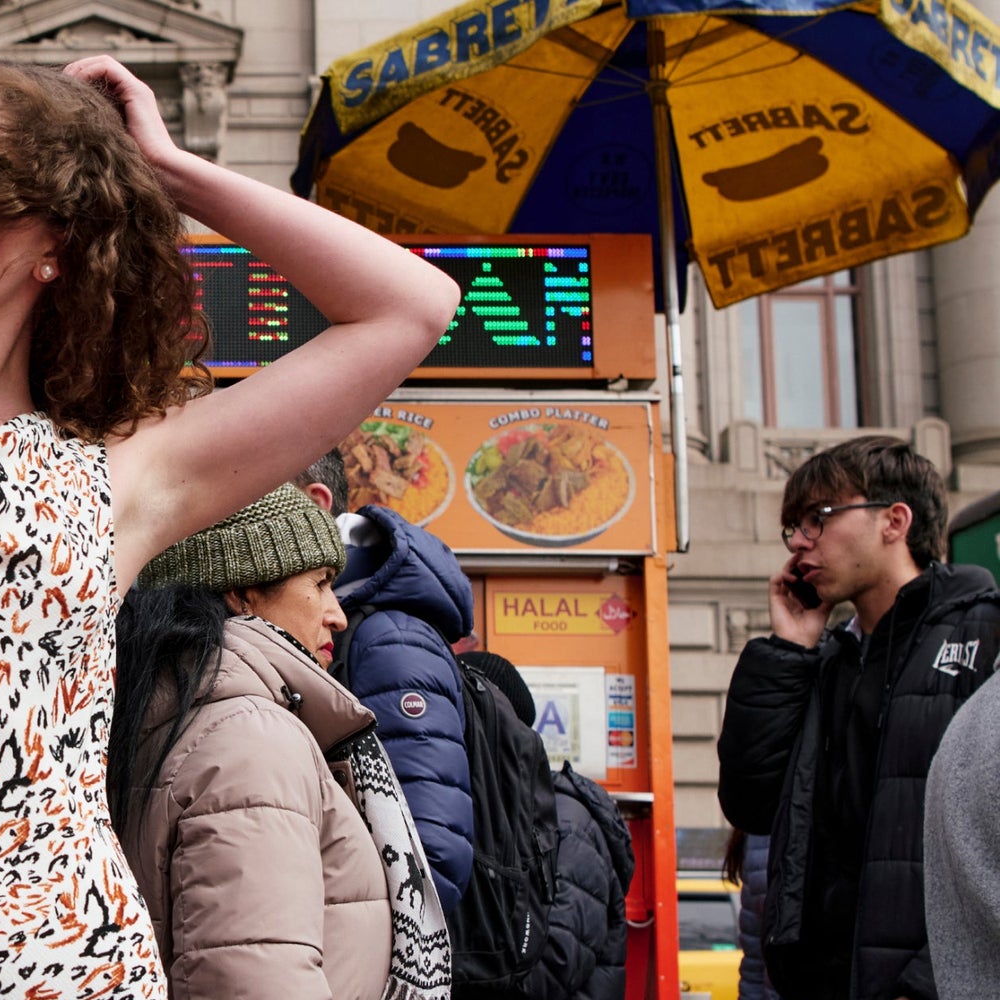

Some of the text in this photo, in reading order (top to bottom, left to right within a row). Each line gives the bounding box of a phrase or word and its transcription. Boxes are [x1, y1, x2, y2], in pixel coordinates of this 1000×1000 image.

[397, 409, 434, 430] RICE
[488, 407, 609, 430] COMBO PLATTER
[502, 597, 588, 617] HALAL
[533, 620, 568, 631] FOOD
[536, 700, 566, 735] A
